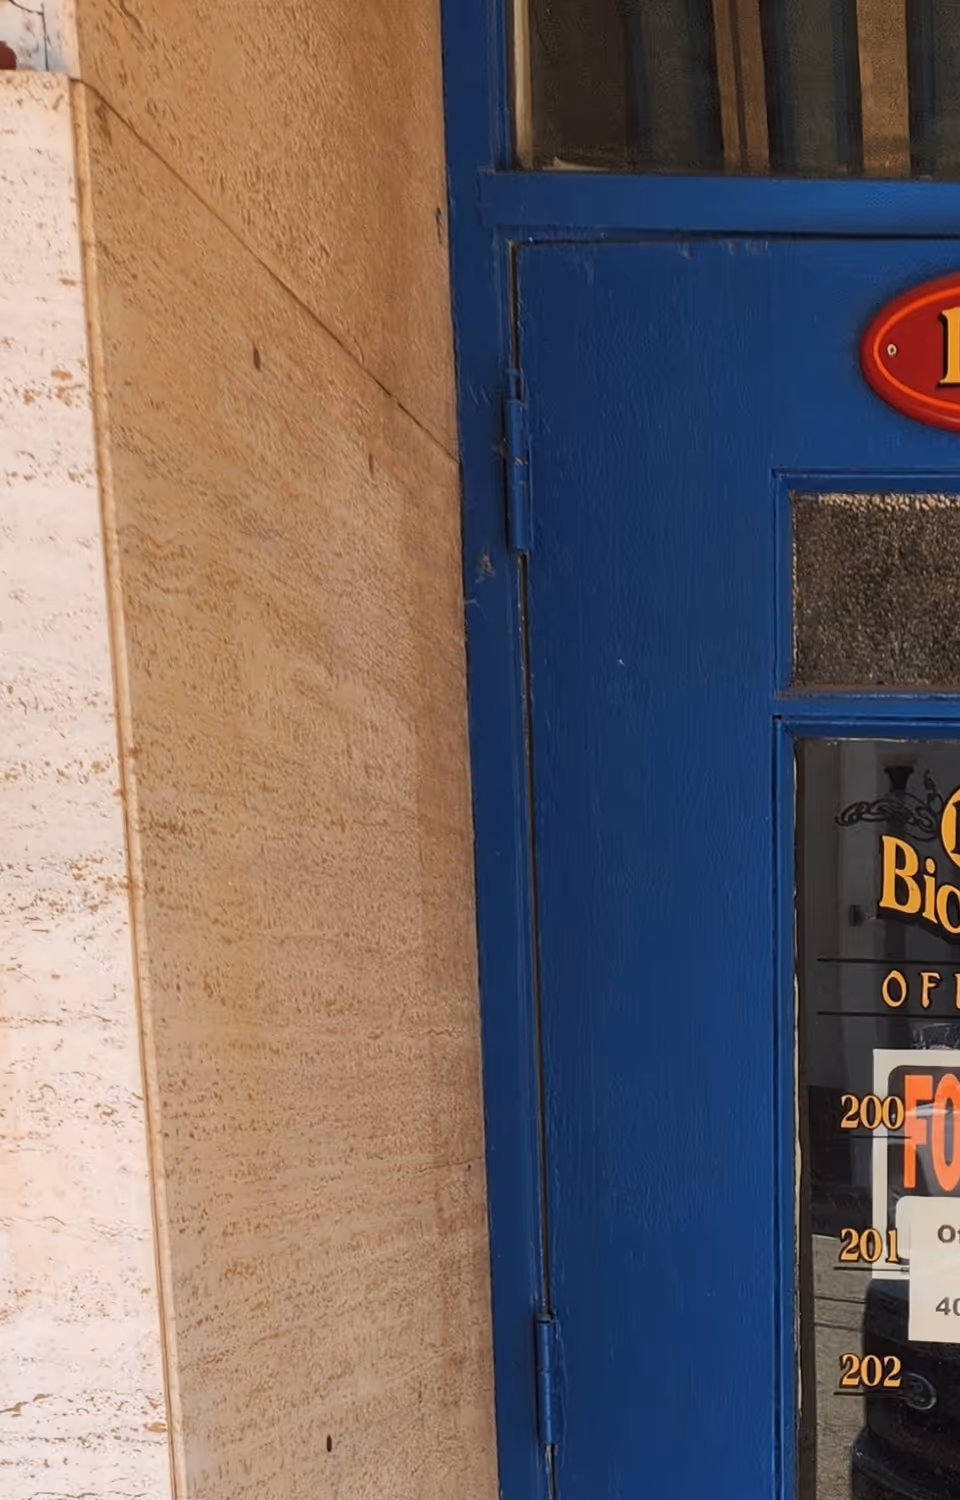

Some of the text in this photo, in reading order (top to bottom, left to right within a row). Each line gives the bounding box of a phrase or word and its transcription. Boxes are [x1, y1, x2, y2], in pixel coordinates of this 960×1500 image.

[840, 1095, 905, 1130] 200
[840, 1228, 899, 1263] 201
[840, 1354, 902, 1388] 202
